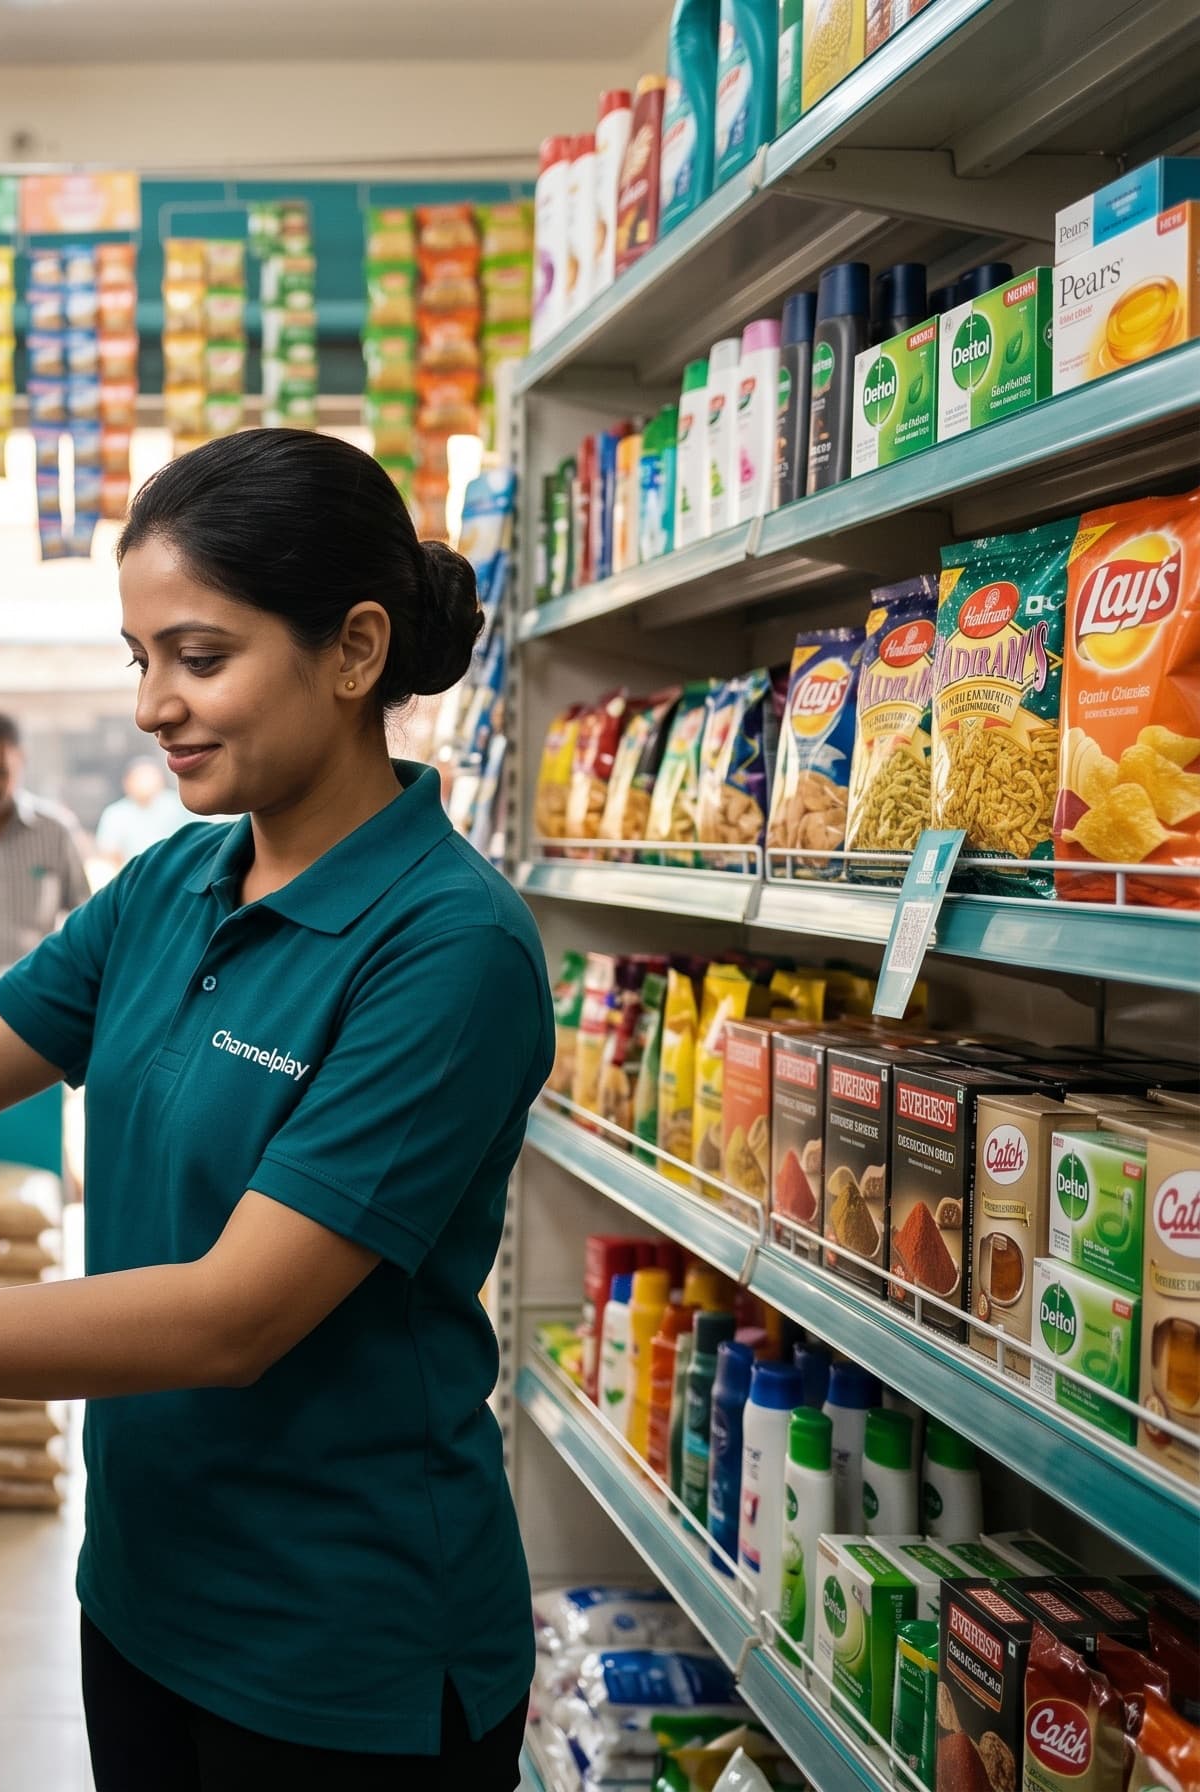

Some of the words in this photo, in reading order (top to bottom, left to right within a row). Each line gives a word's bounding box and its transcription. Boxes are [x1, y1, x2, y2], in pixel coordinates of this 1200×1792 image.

[1059, 217, 1089, 243] Pears
[1059, 260, 1120, 308] Pears
[952, 335, 989, 368] Dettol
[864, 376, 895, 406] Dettol
[1079, 560, 1178, 636] Lay's
[212, 1029, 311, 1081] Channelplay
[986, 1137, 1024, 1170] Catch
[1040, 1302, 1075, 1336] Dettol
[1030, 1707, 1087, 1764] Catch
